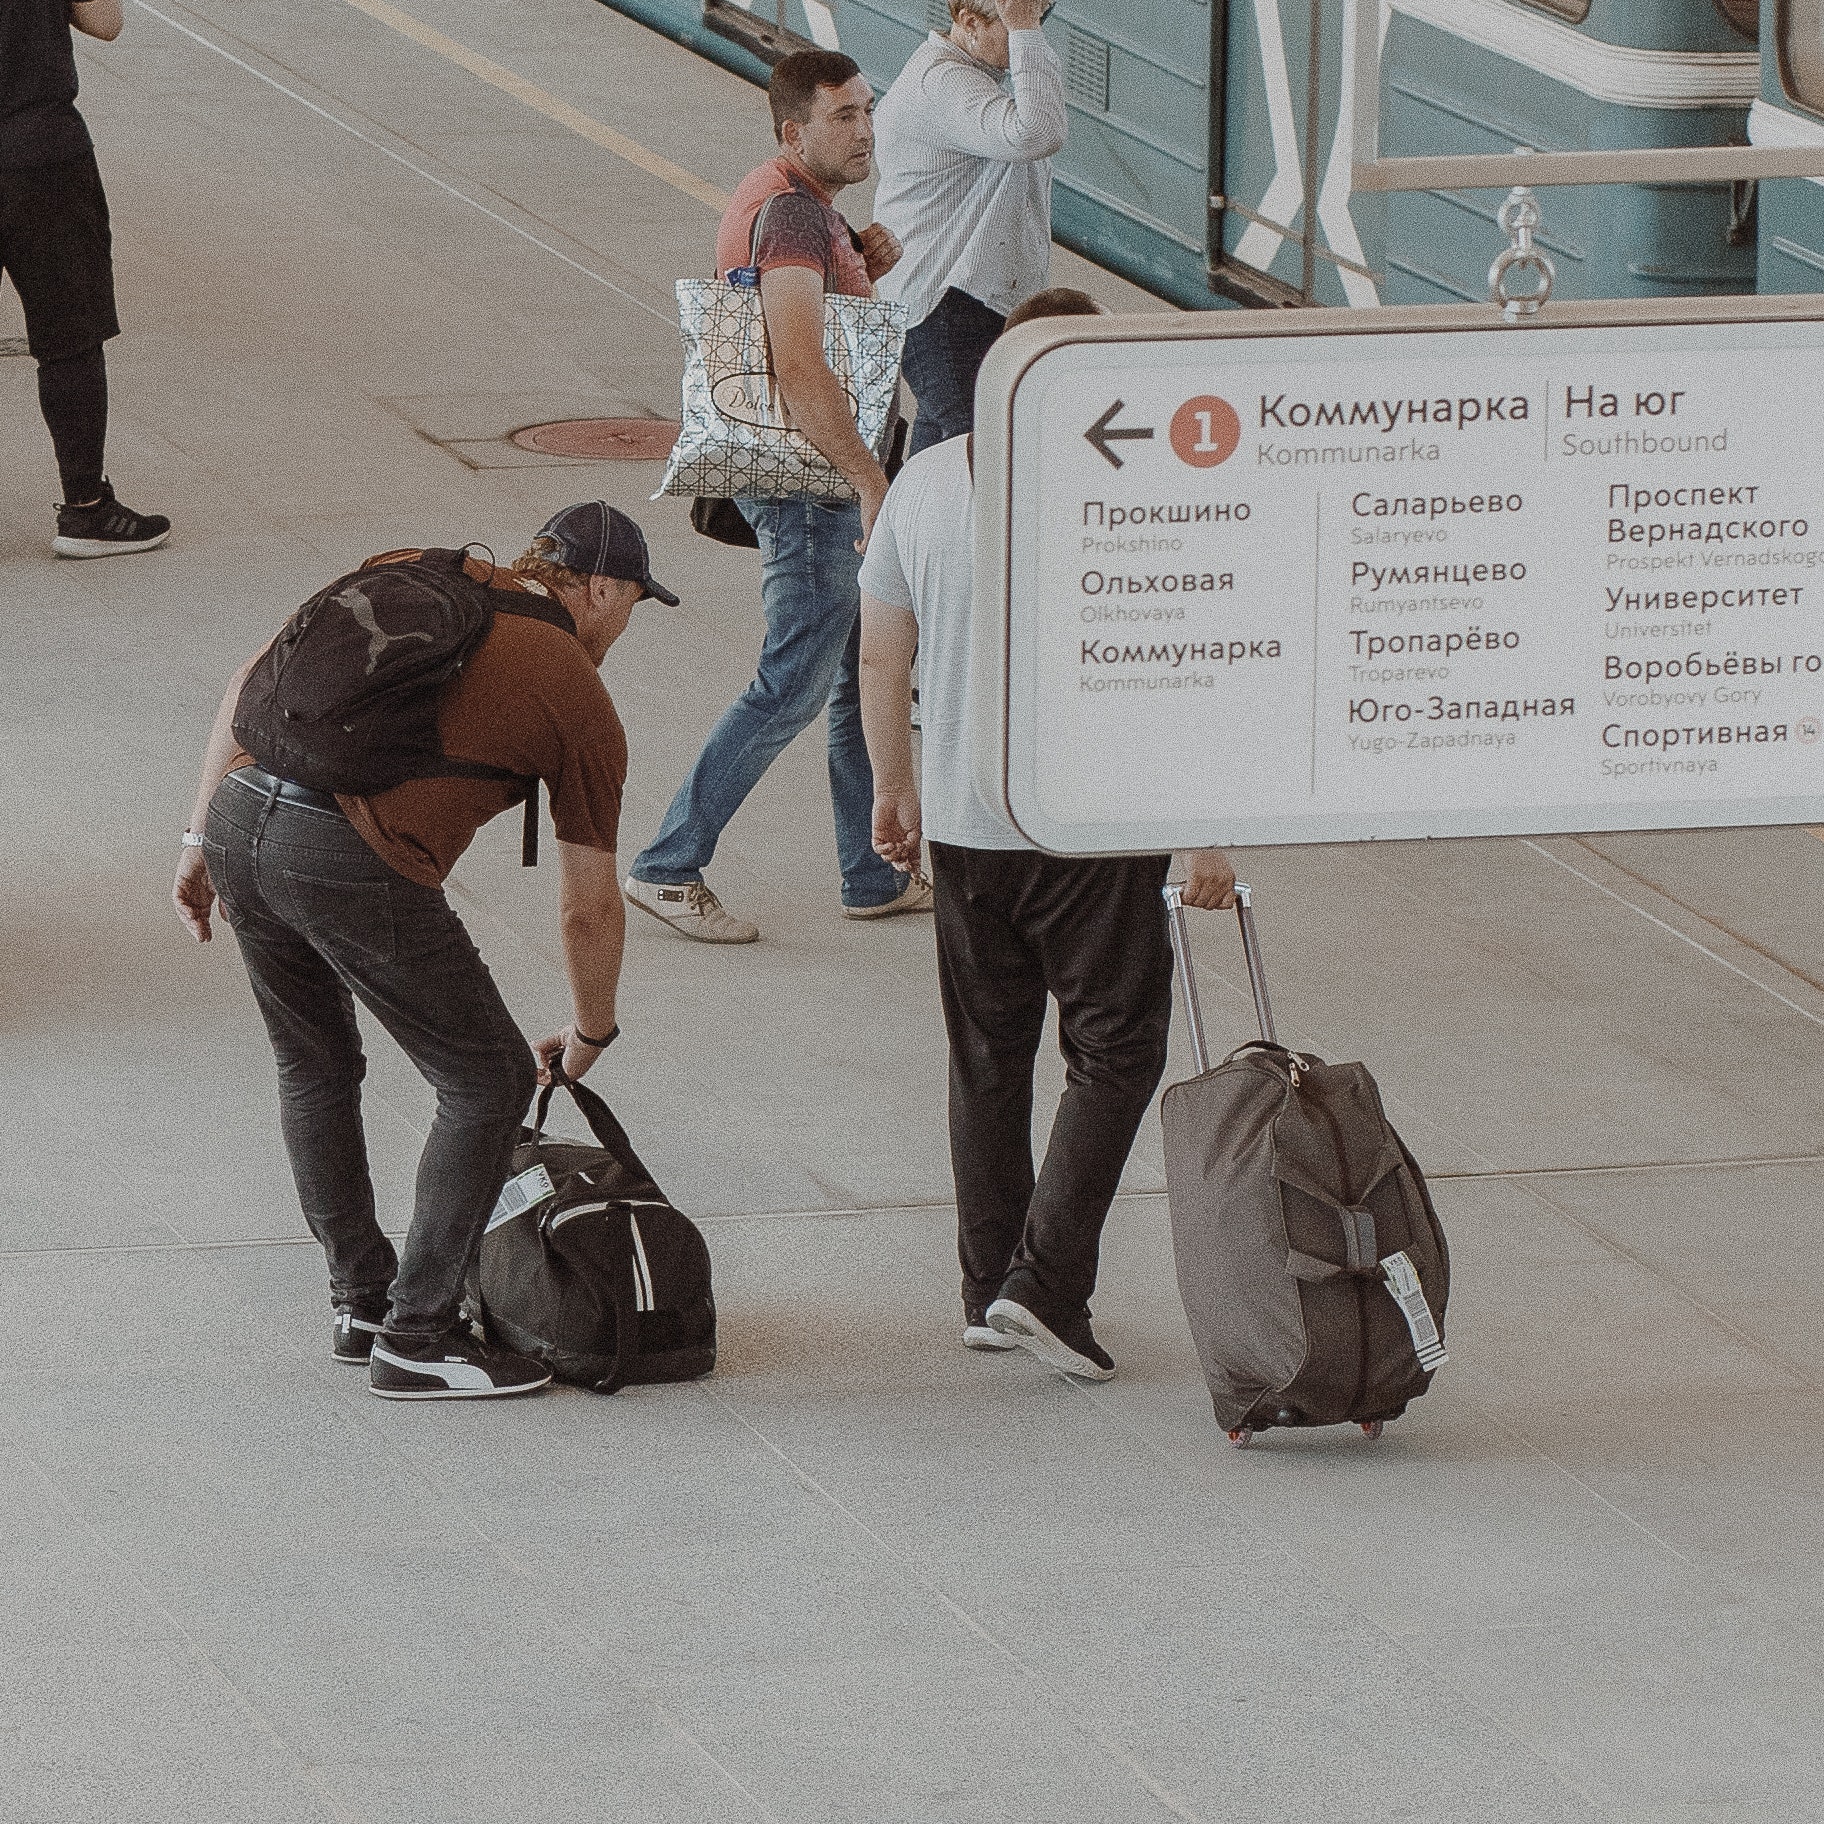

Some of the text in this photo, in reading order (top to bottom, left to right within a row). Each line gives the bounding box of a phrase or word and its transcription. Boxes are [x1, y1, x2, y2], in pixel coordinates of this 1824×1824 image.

[1260, 394, 1529, 434] Коммунарка
[1565, 385, 1686, 419] На юг
[1193, 412, 1218, 452] 1
[1563, 428, 1729, 457] Southbound
[1258, 438, 1440, 465] Kommunarka
[1351, 491, 1524, 521] Саларьево
[1608, 483, 1759, 514] Проспект
[1083, 500, 1252, 532] Прокшино
[1082, 536, 1183, 554] Prokshino
[1352, 525, 1447, 546] Salaryevo
[1607, 517, 1809, 548] Вернадского
[1606, 553, 1694, 571] Prospekt
[1080, 569, 1234, 596] Ольховая
[1351, 560, 1527, 593] Румянцево
[1081, 604, 1185, 624] Olkhovaya
[1351, 593, 1484, 615] Rumyantsevo
[1605, 586, 1804, 614] Университет
[1348, 625, 1520, 661] Тропарёво
[1606, 622, 1711, 639] Universitet
[1080, 639, 1282, 668] Коммунарка
[1604, 650, 1782, 685] Воробьёвы
[1080, 672, 1215, 693] Kommunarka
[1349, 662, 1450, 684] Troparevo
[1348, 695, 1576, 724] Юго-Западная
[1603, 686, 1762, 708] Vorobyovy Gory
[1348, 729, 1517, 753] Yugo-Zapadnaya
[1601, 722, 1788, 752] Спортивная
[1602, 758, 1717, 777] Sportivnaya
